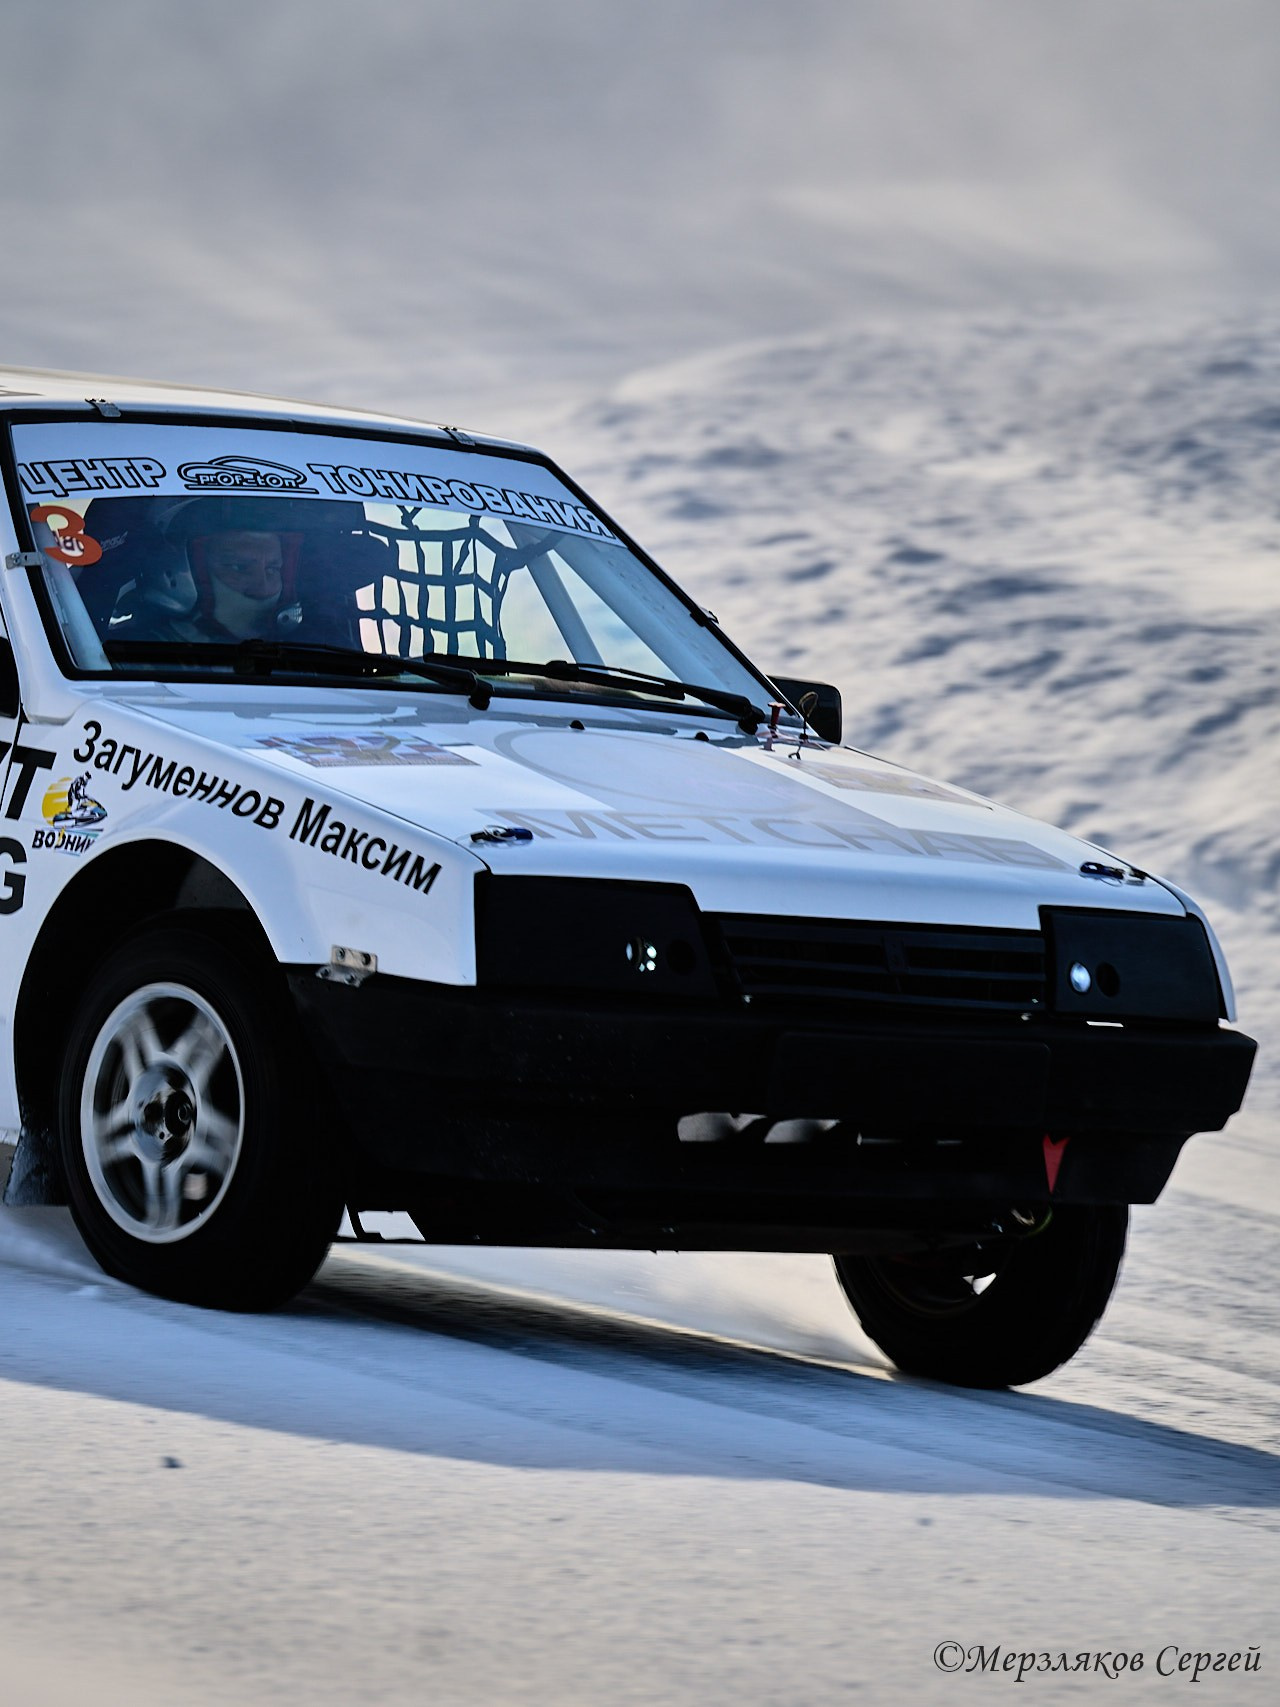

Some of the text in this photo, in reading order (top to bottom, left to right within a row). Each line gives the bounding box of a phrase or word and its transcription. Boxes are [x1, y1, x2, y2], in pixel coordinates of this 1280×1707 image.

[18, 456, 167, 497] ЦЕНТР
[306, 463, 614, 538] ТОНИРОВАНИЯ
[30, 505, 103, 566] 3
[73, 720, 442, 895] Загуменнов Максим
